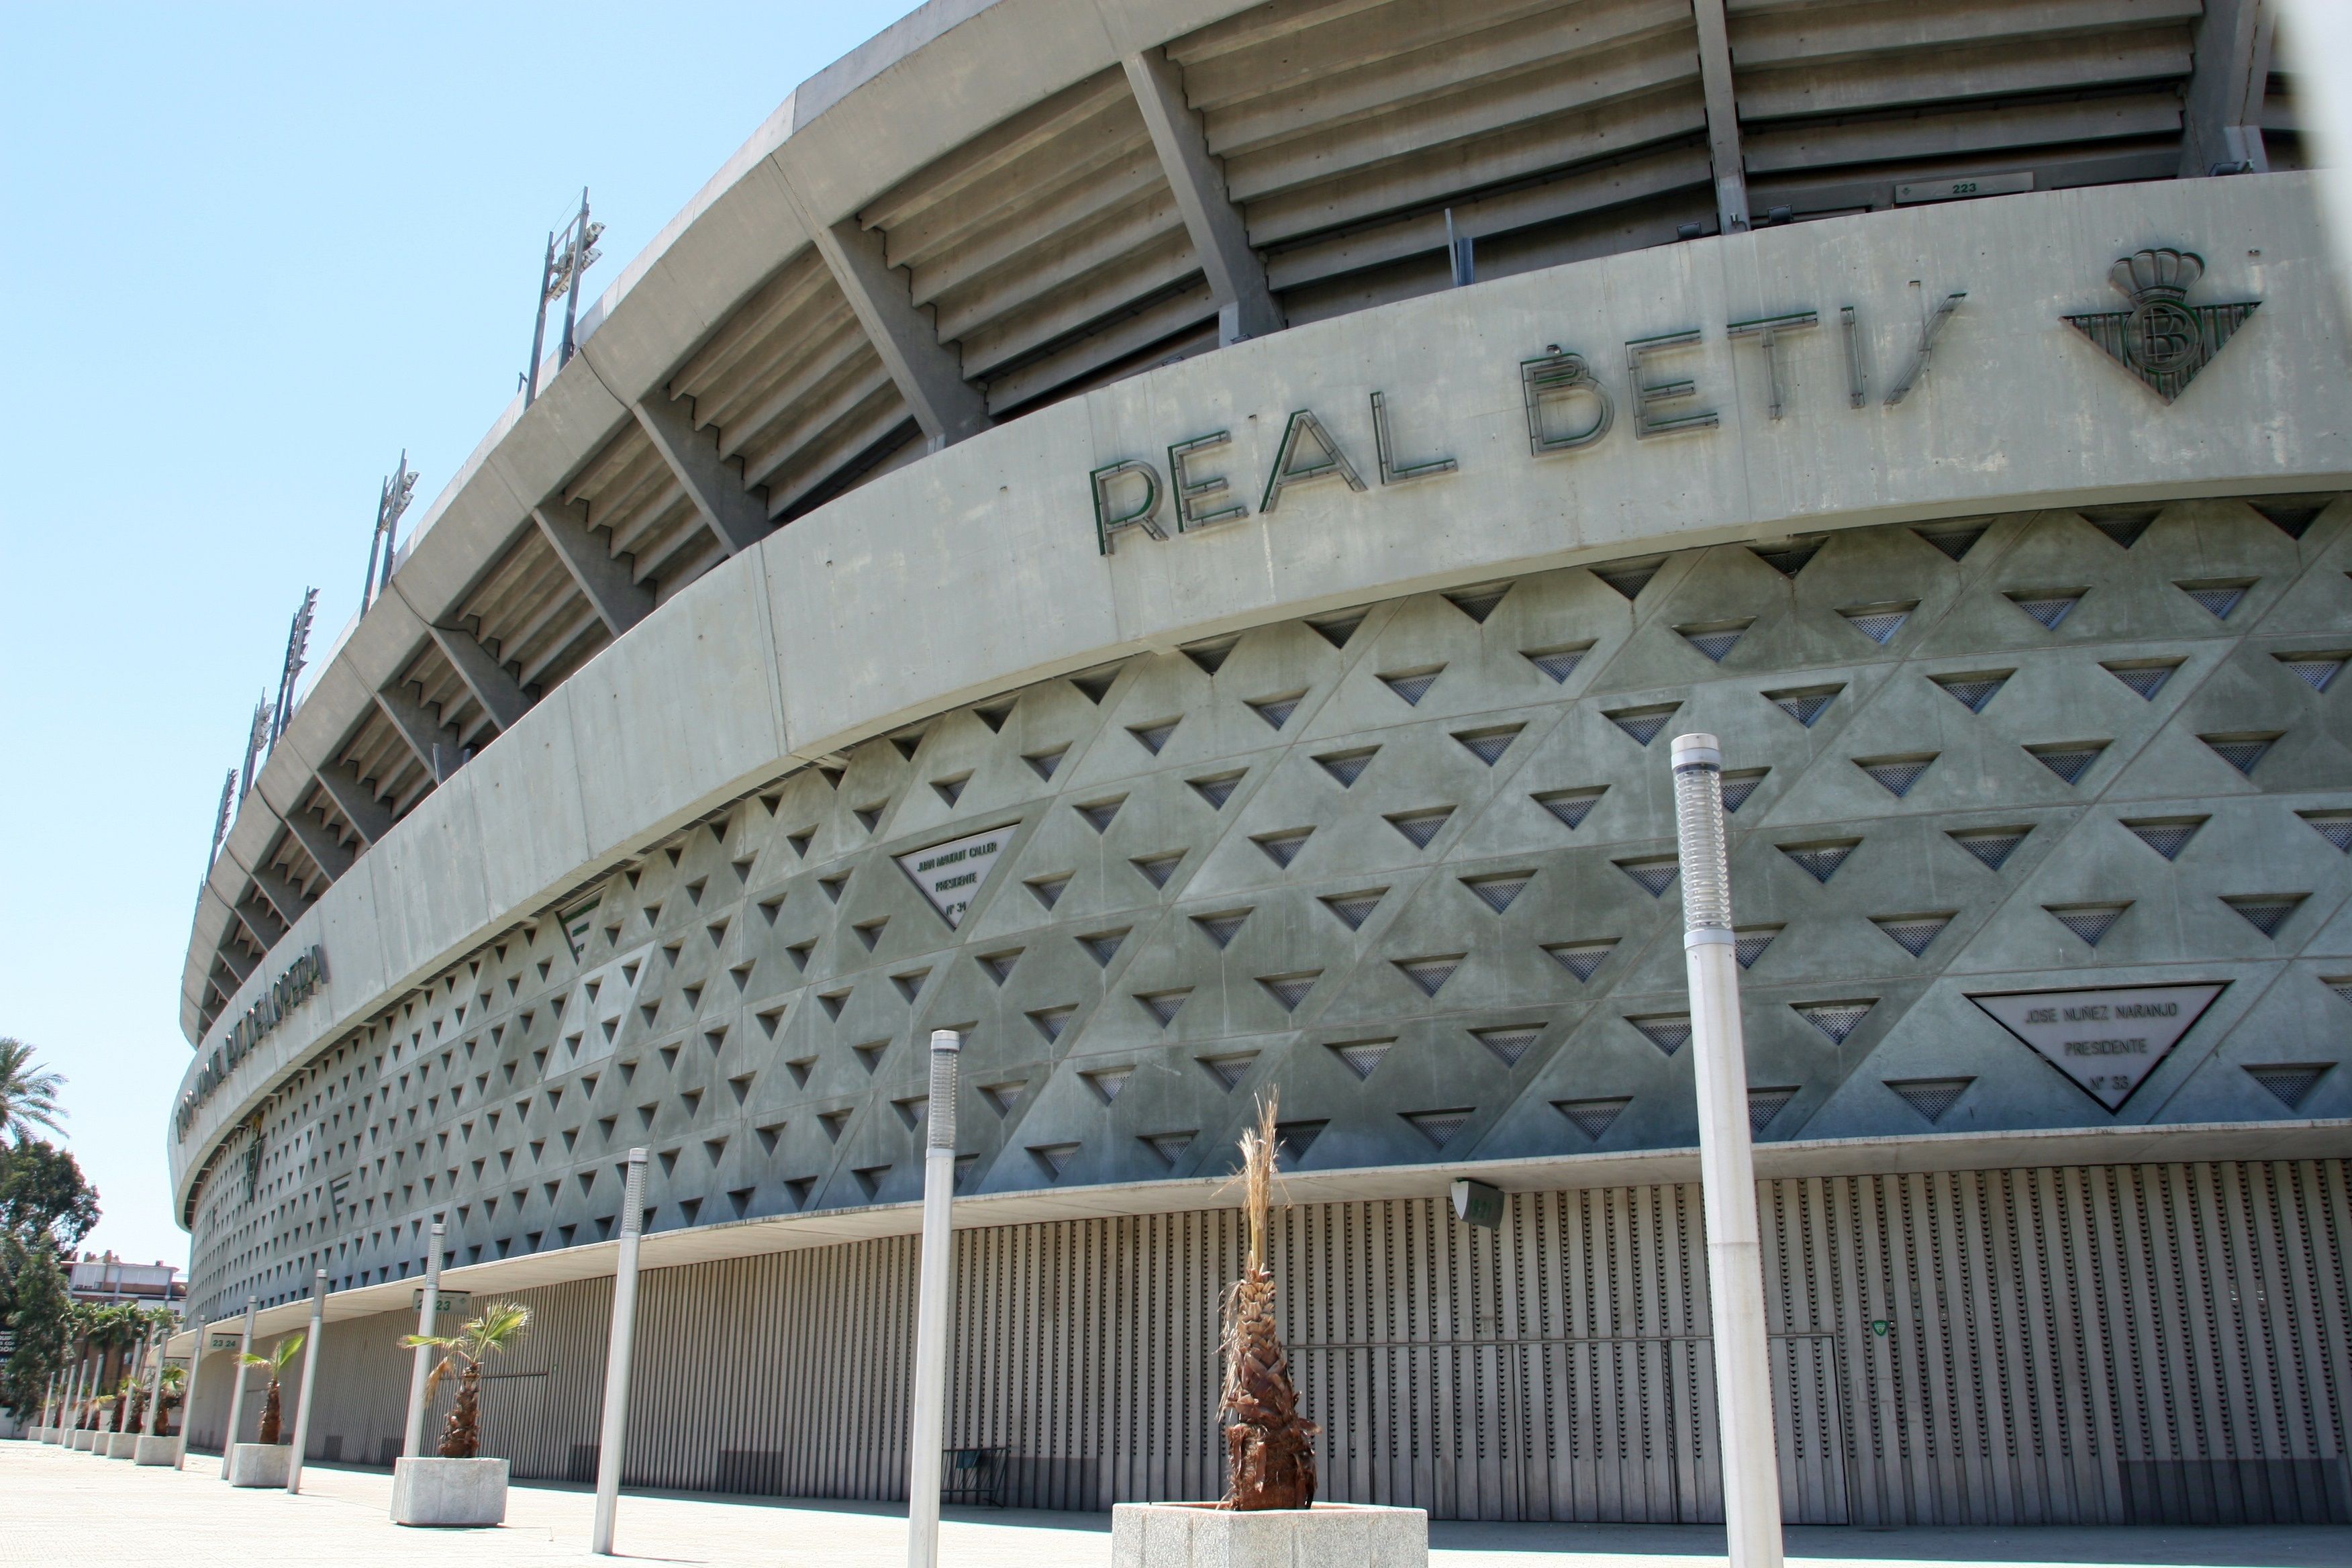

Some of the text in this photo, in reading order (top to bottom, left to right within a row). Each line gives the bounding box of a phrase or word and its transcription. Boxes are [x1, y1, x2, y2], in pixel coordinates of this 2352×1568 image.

[1952, 183, 1977, 194] 223
[1089, 391, 1459, 556] REAL
[969, 842, 997, 857] CALLER
[936, 873, 977, 892] PRESIDENTE
[957, 901, 967, 912] 34
[2024, 1002, 2178, 1024] JOSE NUÑEZ NARANJO
[2065, 1038, 2147, 1055] PRESIDENTE
[2112, 1075, 2129, 1089] 33
[436, 1301, 450, 1310] 23
